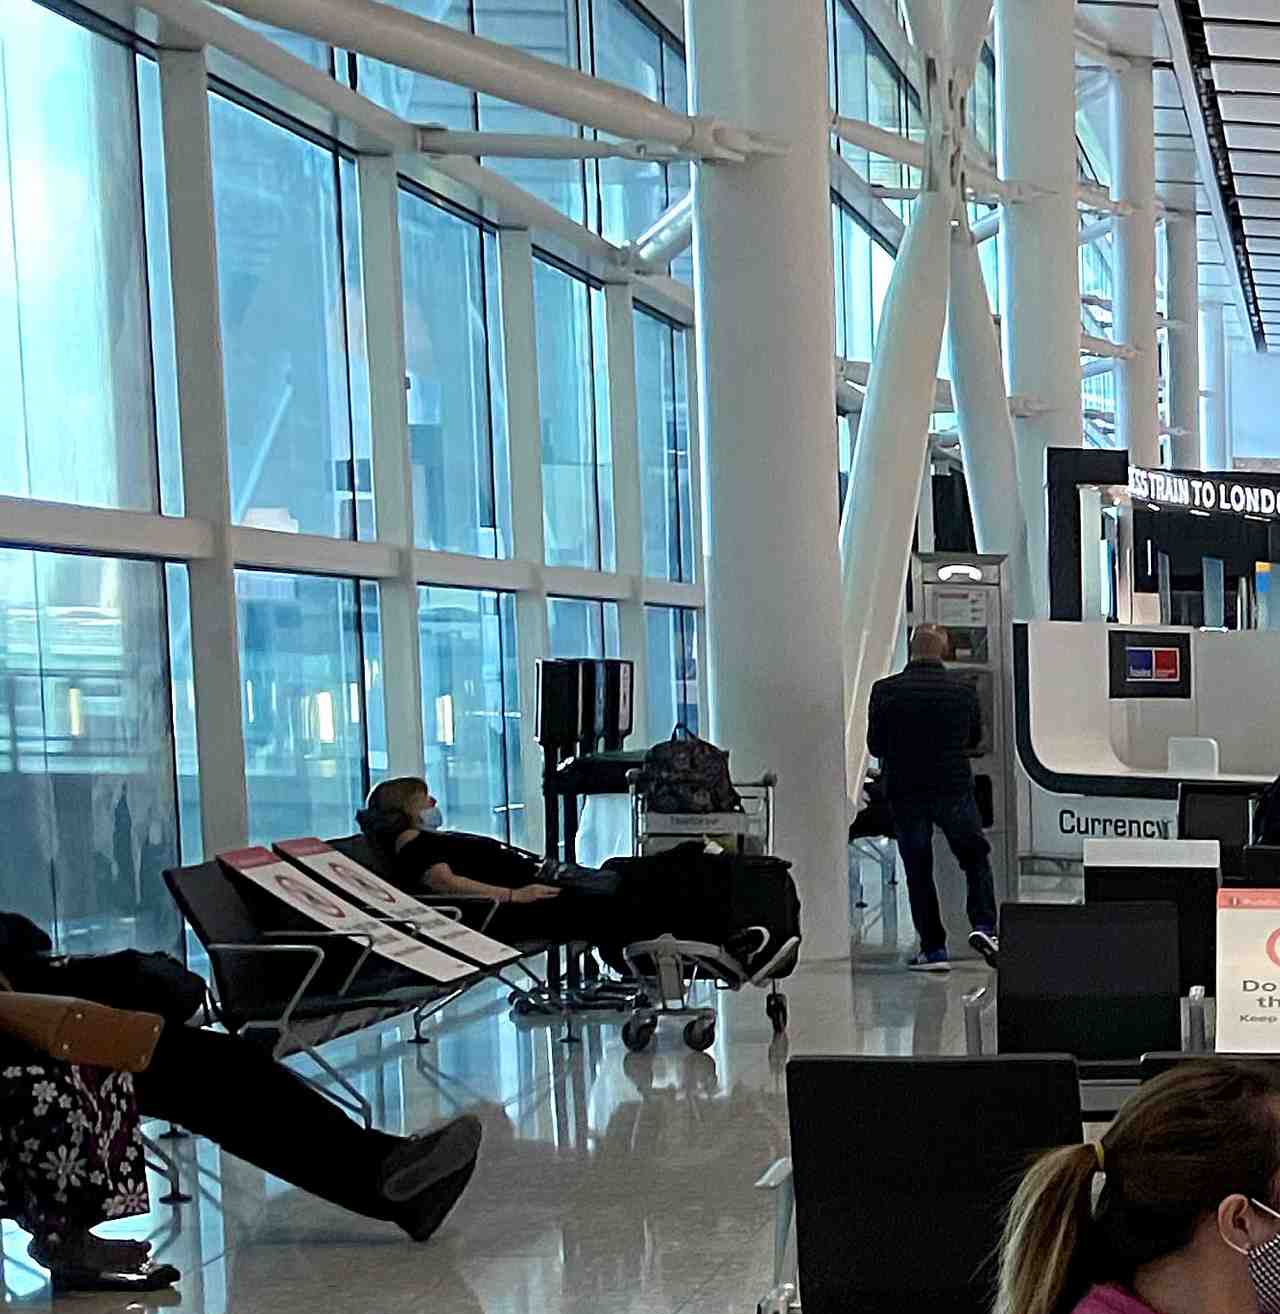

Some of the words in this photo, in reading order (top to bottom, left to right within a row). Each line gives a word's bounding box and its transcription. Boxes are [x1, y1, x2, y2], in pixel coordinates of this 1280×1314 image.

[1149, 471, 1189, 505] TRAIN
[1190, 480, 1215, 508] TO
[1242, 979, 1277, 993] Do
[1239, 1014, 1277, 1023] Keep
